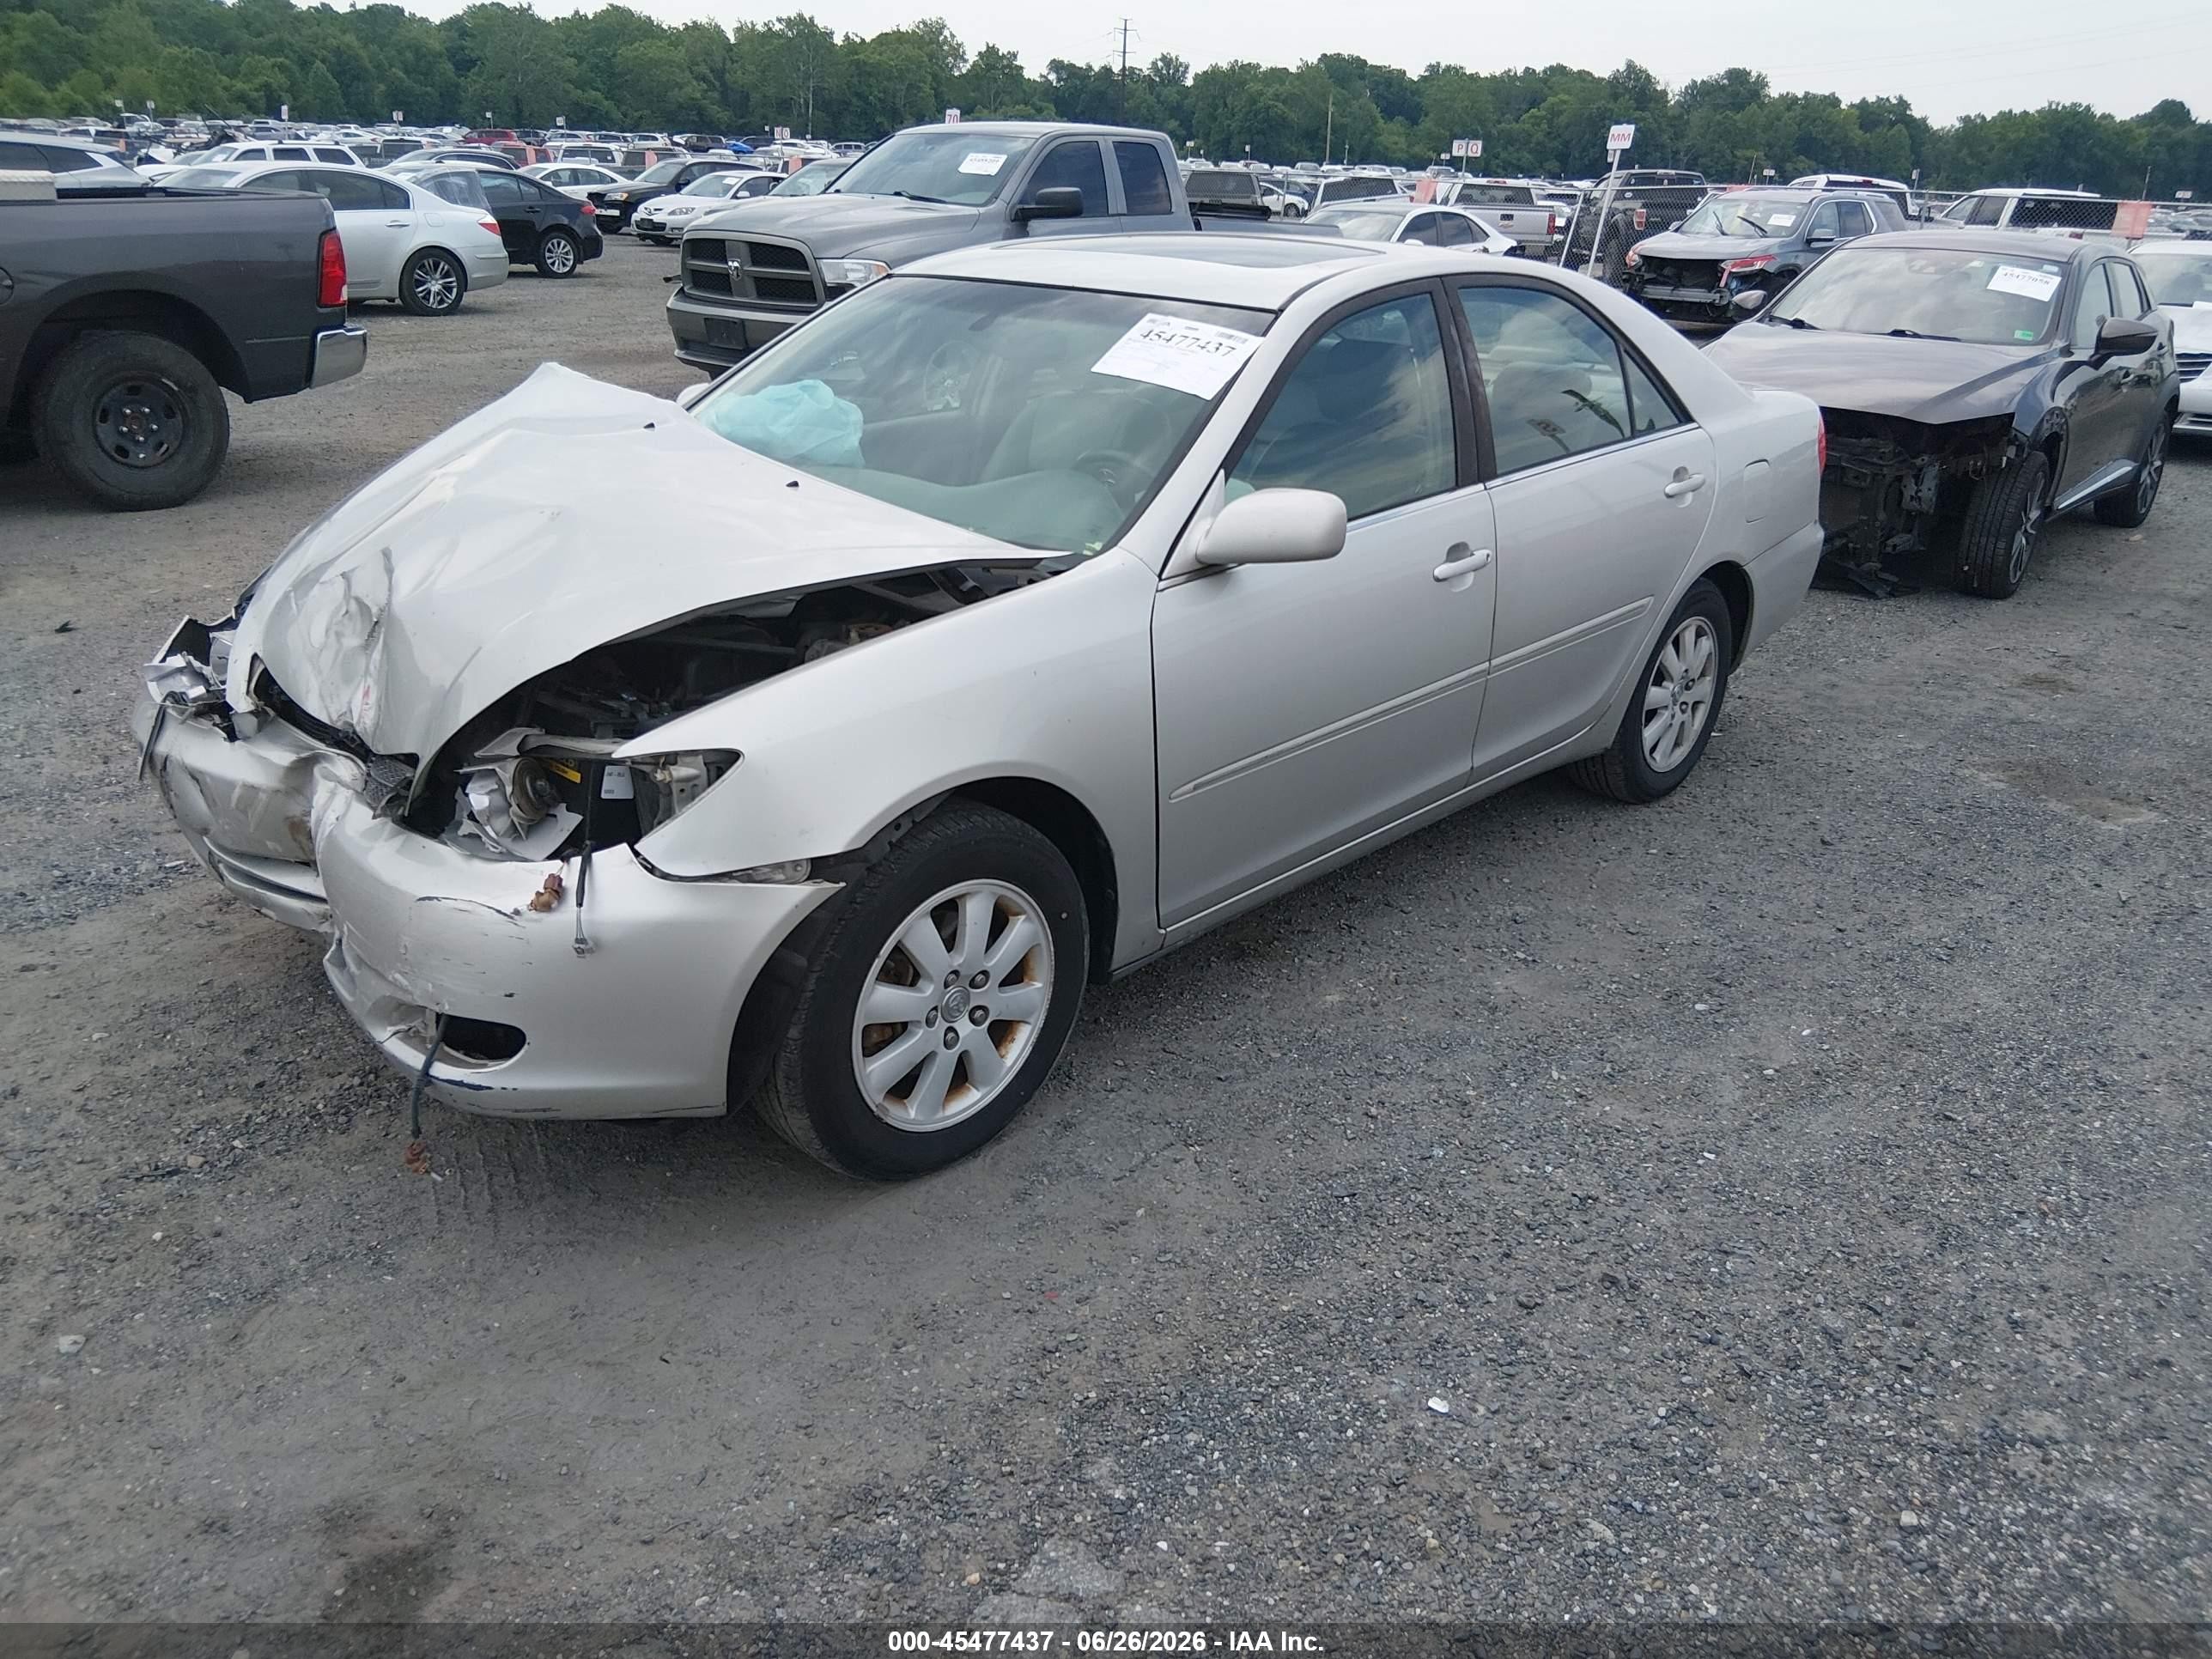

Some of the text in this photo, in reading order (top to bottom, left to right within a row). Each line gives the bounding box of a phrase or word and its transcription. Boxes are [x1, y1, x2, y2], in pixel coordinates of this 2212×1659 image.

[1609, 132, 1631, 143] MM
[1456, 143, 1464, 154] P
[1470, 143, 1479, 155] Q
[1139, 329, 1237, 357] 45477437
